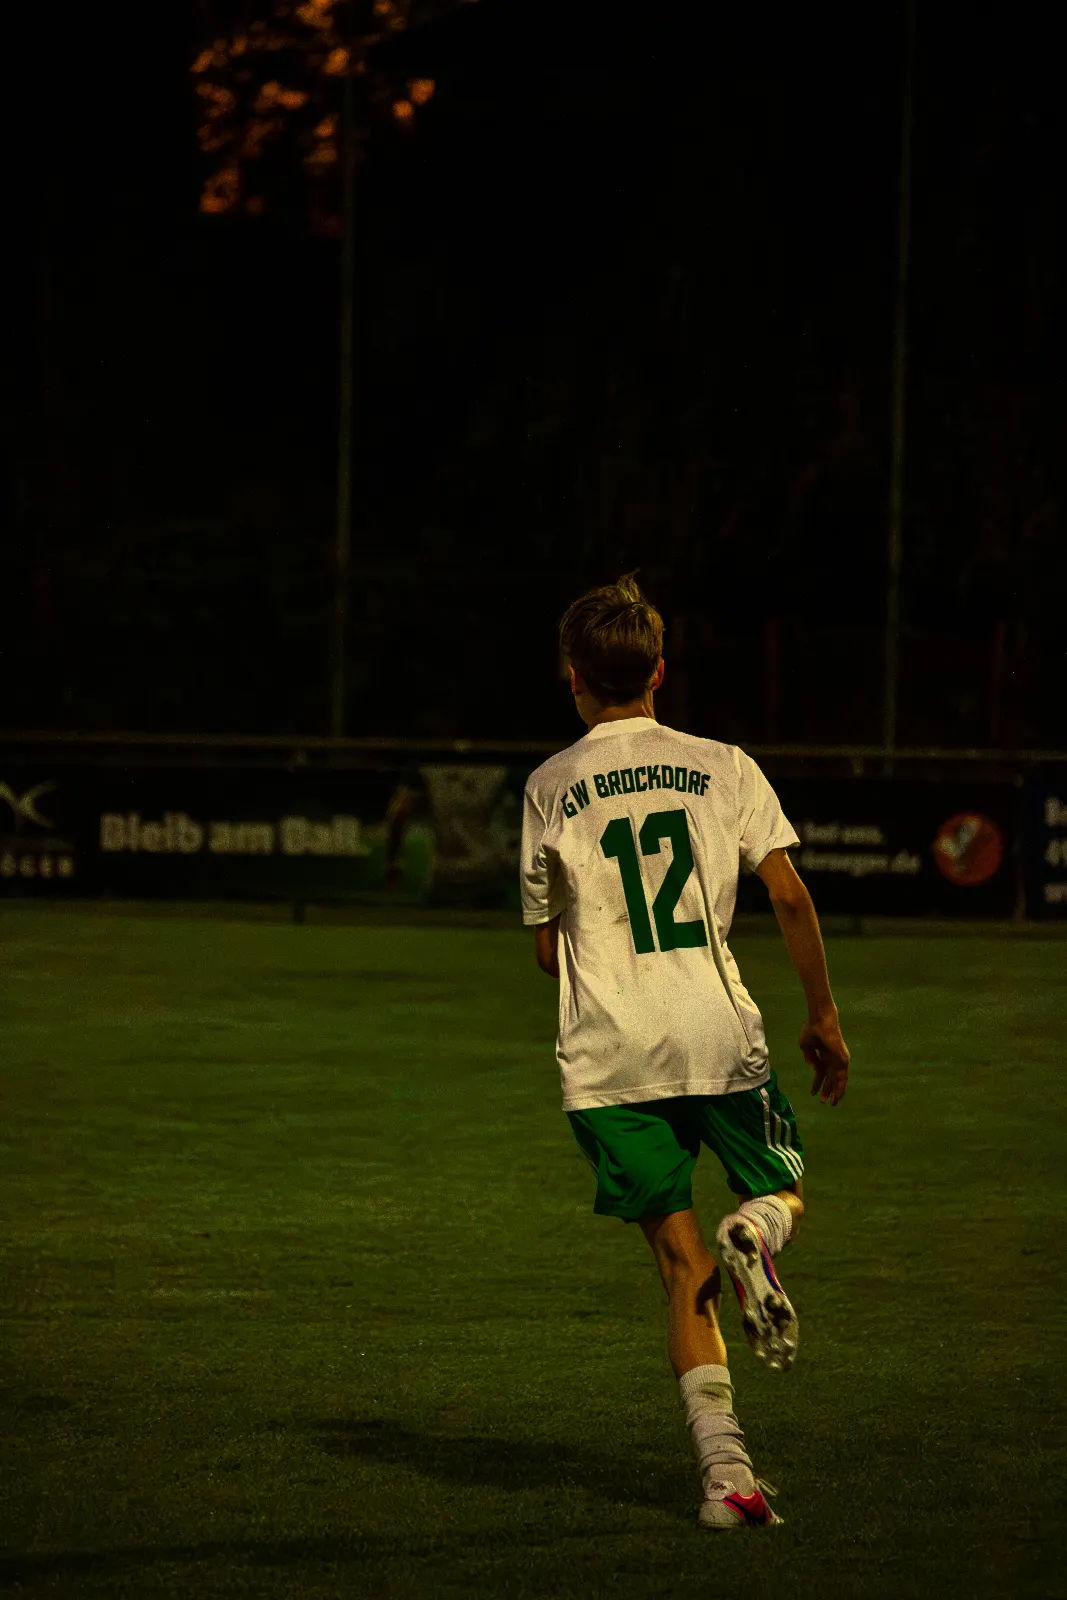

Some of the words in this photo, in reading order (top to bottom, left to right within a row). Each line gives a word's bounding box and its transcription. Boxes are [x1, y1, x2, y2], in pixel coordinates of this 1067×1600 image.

[561, 779, 591, 819] GW
[593, 764, 711, 799] BROCKDORF
[208, 820, 274, 855] am
[599, 808, 709, 955] 12
